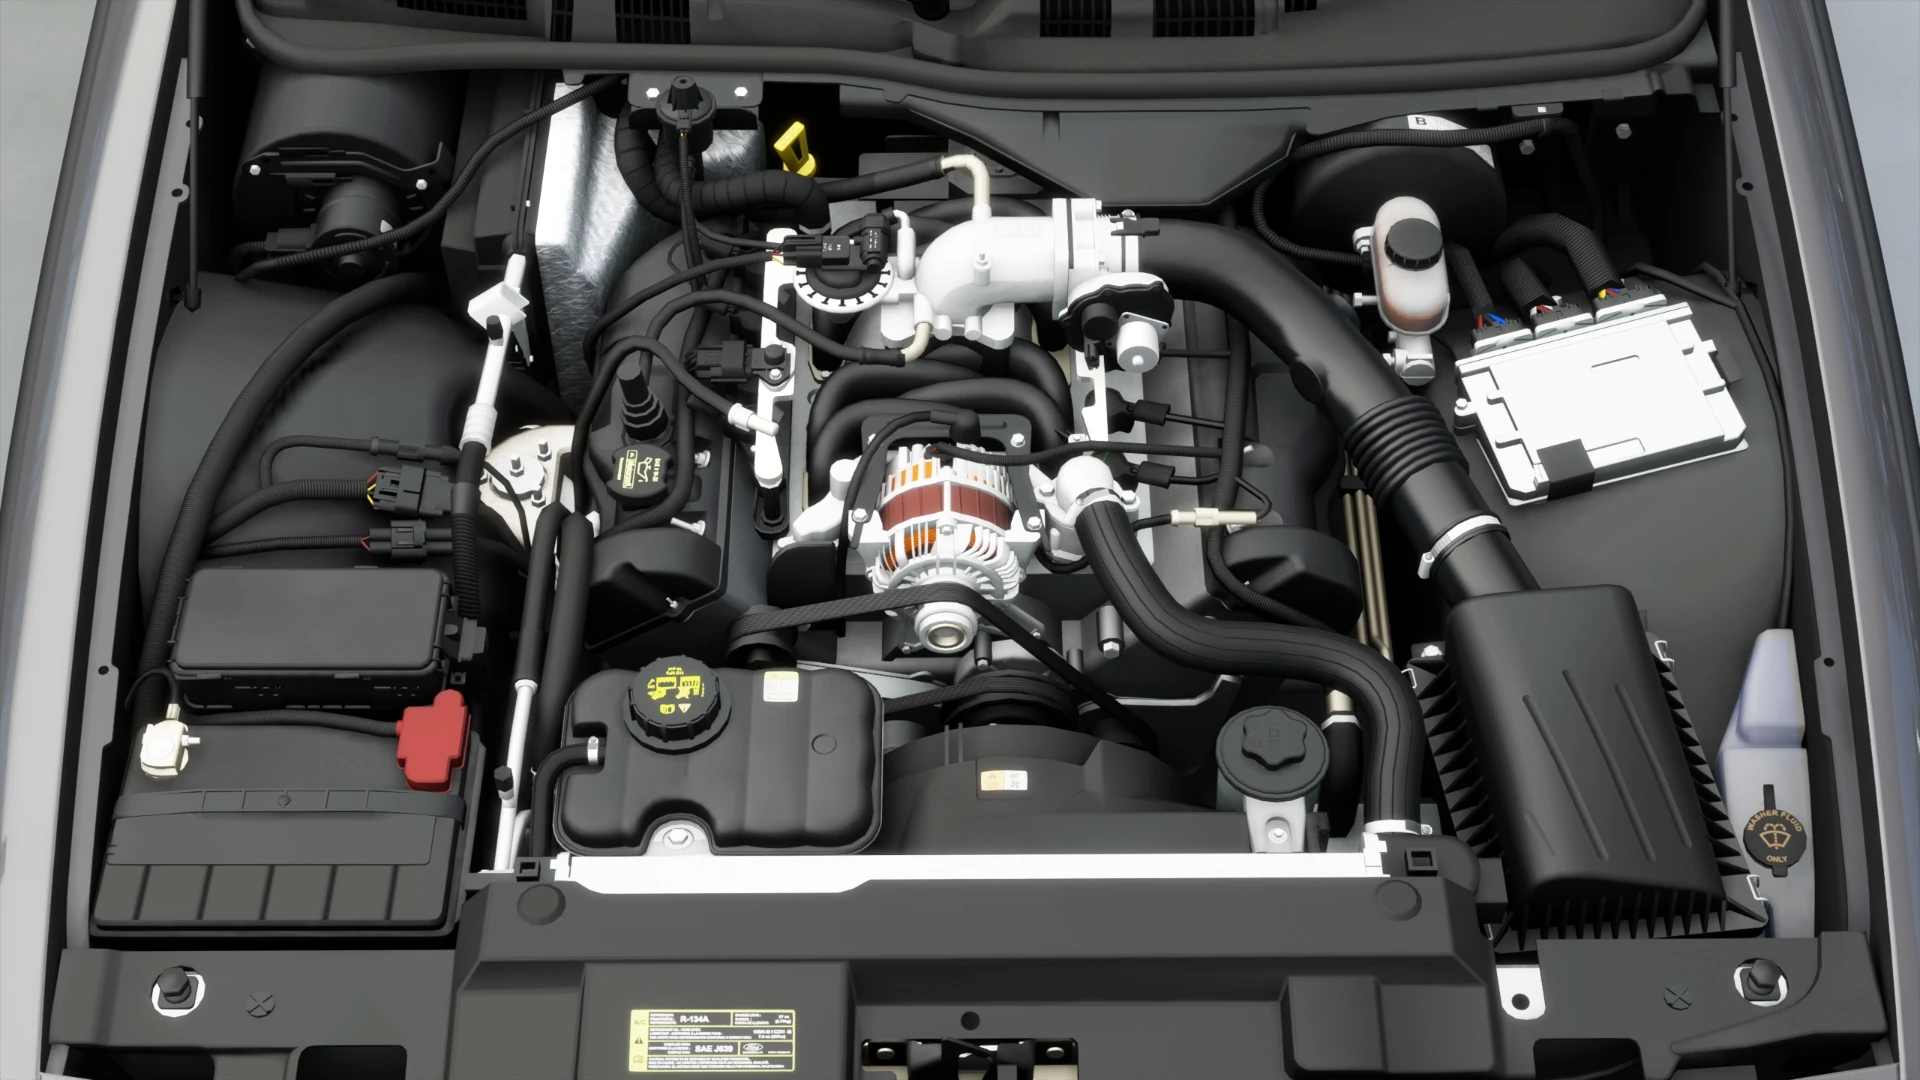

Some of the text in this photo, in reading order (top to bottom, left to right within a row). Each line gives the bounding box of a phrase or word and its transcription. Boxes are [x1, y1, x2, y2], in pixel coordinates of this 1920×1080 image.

[1415, 117, 1427, 125] B
[1747, 809, 1803, 832] WASHER FLUID
[1766, 855, 1788, 863] ONLY
[680, 1015, 710, 1023] R-134A
[695, 1045, 713, 1053] SAE
[714, 1045, 734, 1053] J639
